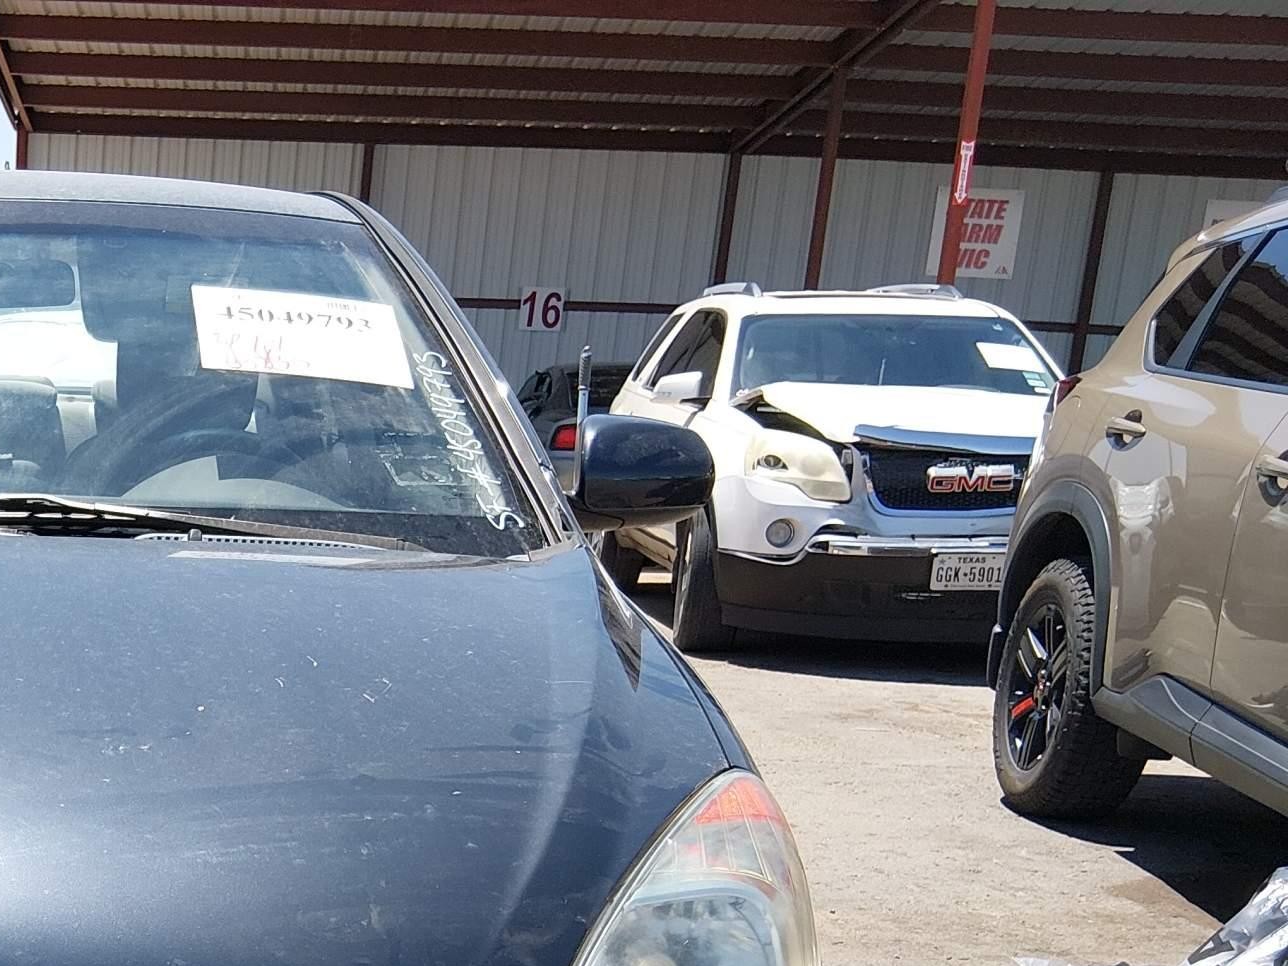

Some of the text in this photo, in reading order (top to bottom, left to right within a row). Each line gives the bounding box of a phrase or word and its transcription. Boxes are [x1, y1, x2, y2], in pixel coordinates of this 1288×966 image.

[964, 198, 1010, 220] TATE
[961, 223, 1004, 245] RM
[523, 291, 562, 328] 16
[928, 474, 1013, 492] GMC
[957, 556, 987, 564] TEXAS
